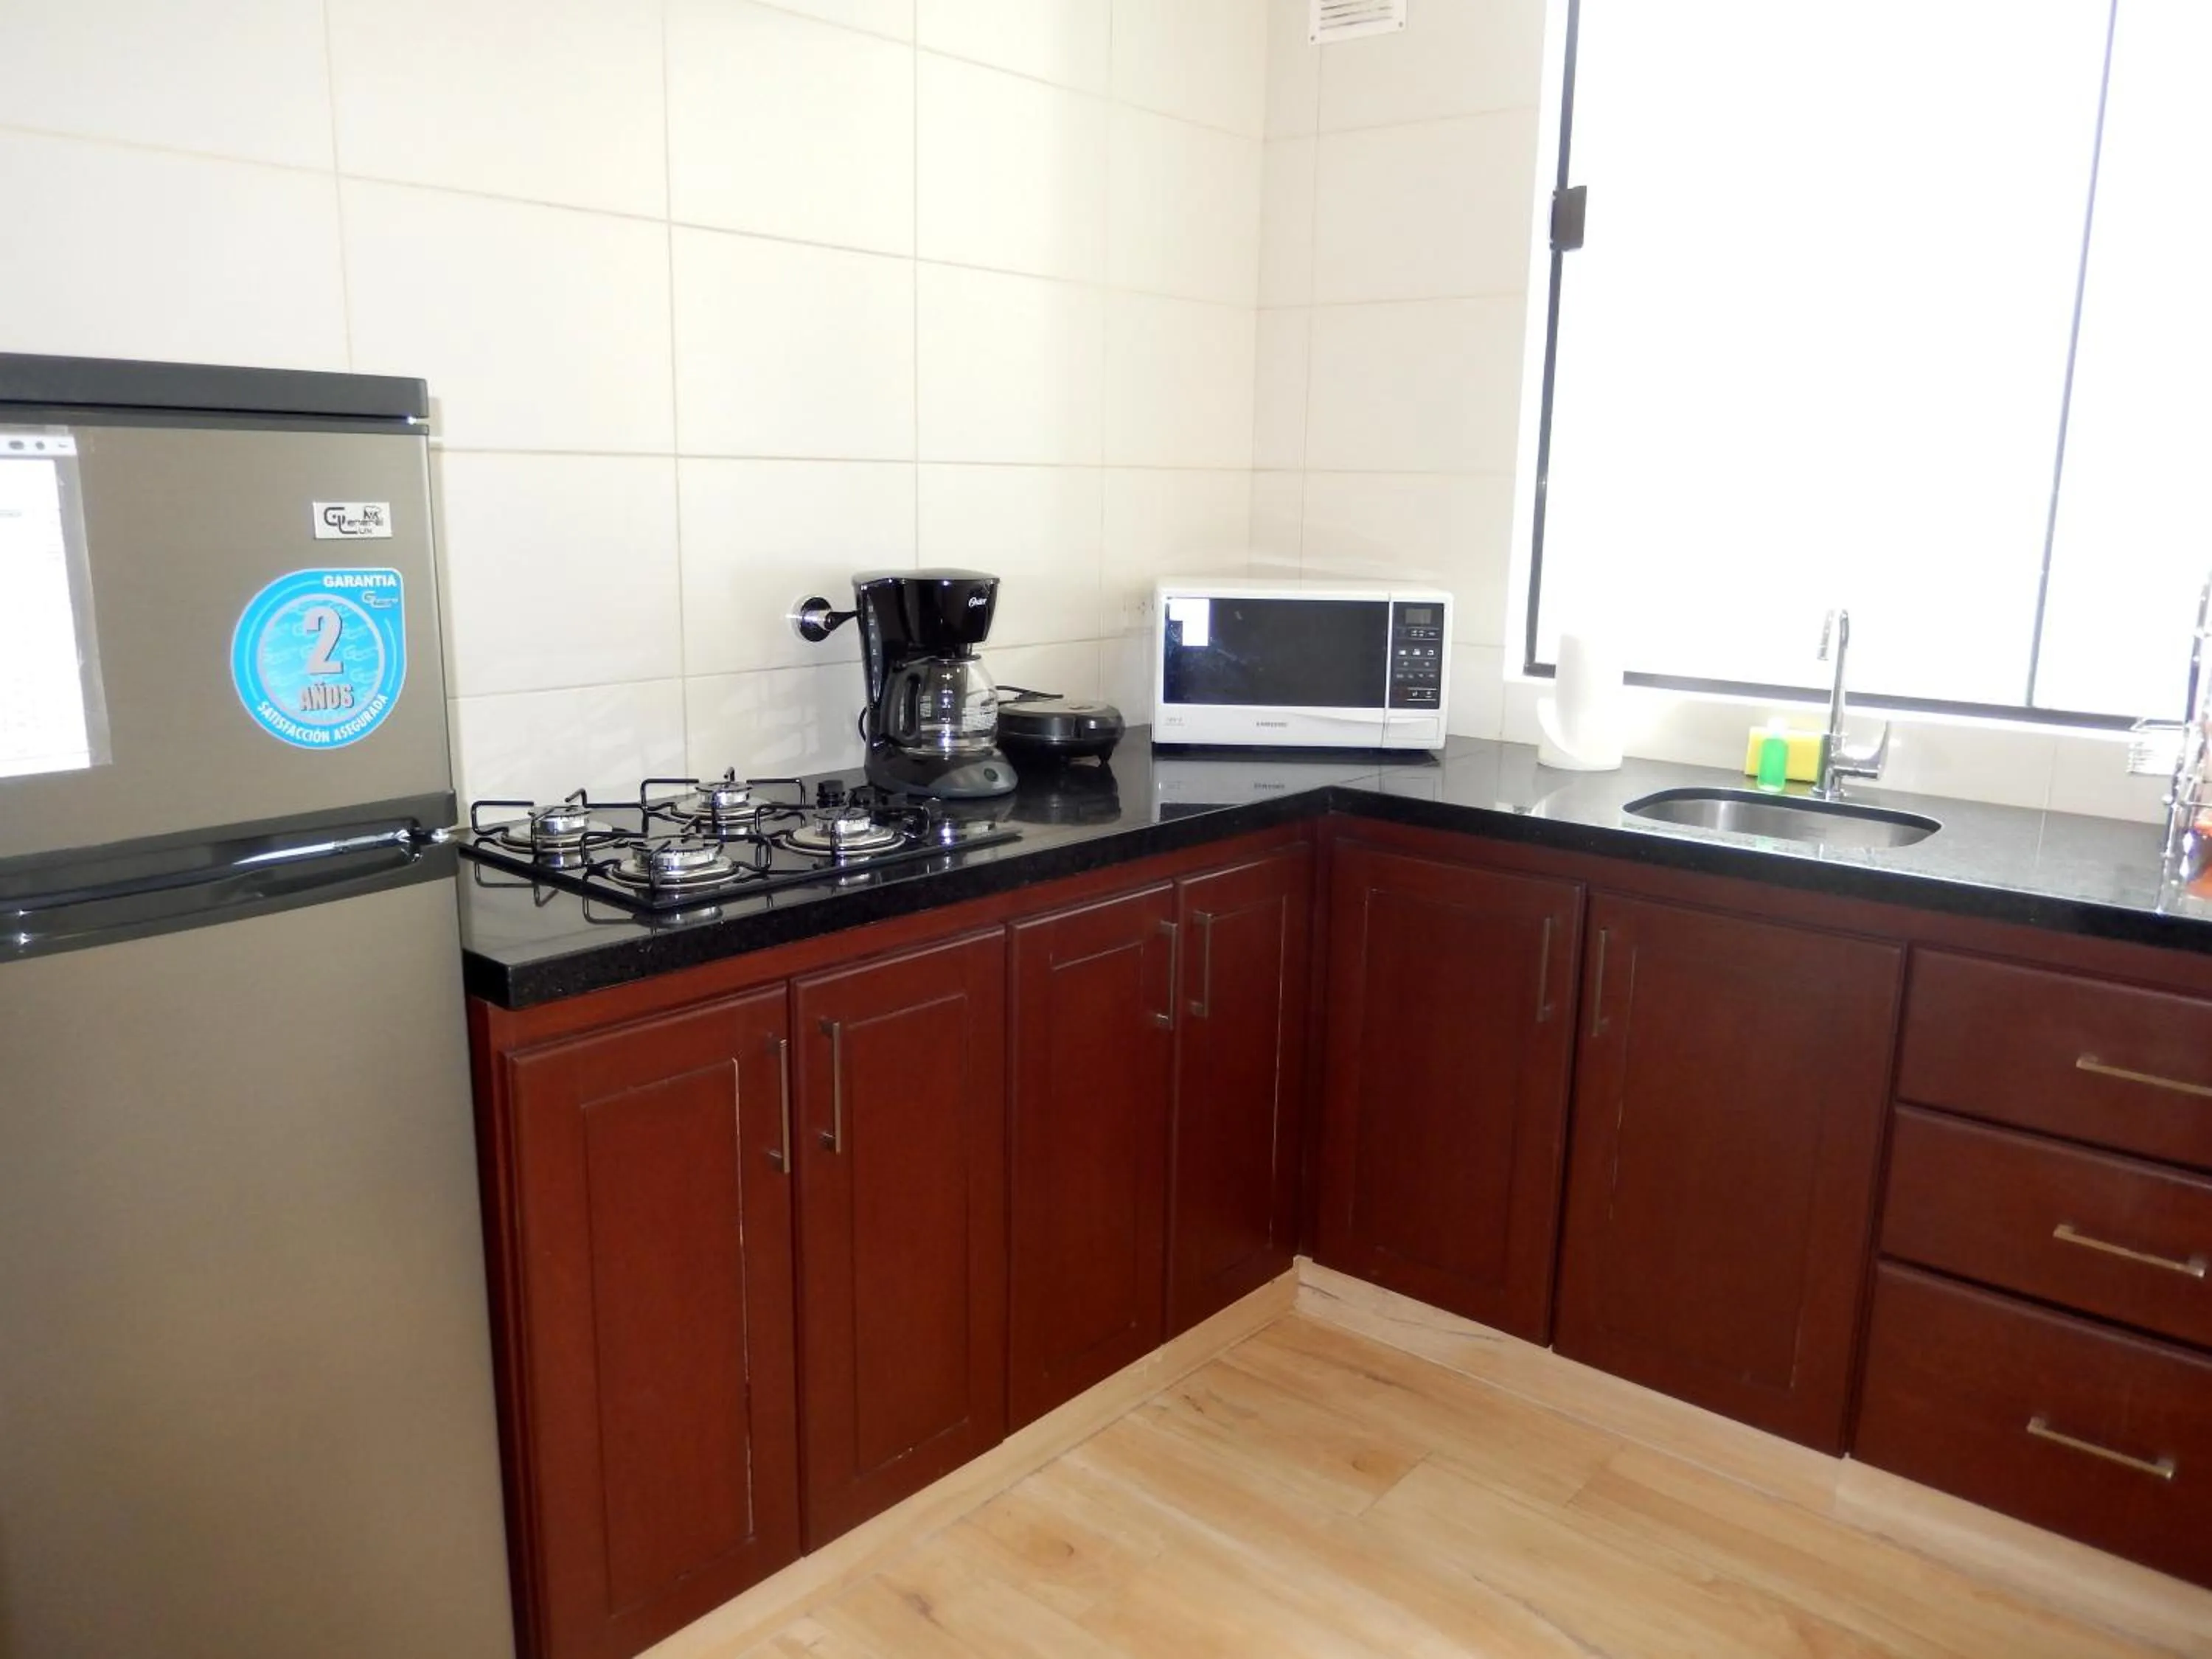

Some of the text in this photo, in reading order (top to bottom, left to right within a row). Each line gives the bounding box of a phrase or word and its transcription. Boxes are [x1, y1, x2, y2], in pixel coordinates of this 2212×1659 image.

[323, 574, 397, 588] GARANTIA
[303, 605, 344, 675] 2
[300, 681, 355, 712] AÑOS
[257, 693, 389, 743] SATISFACCIÓN ASEGURADA
